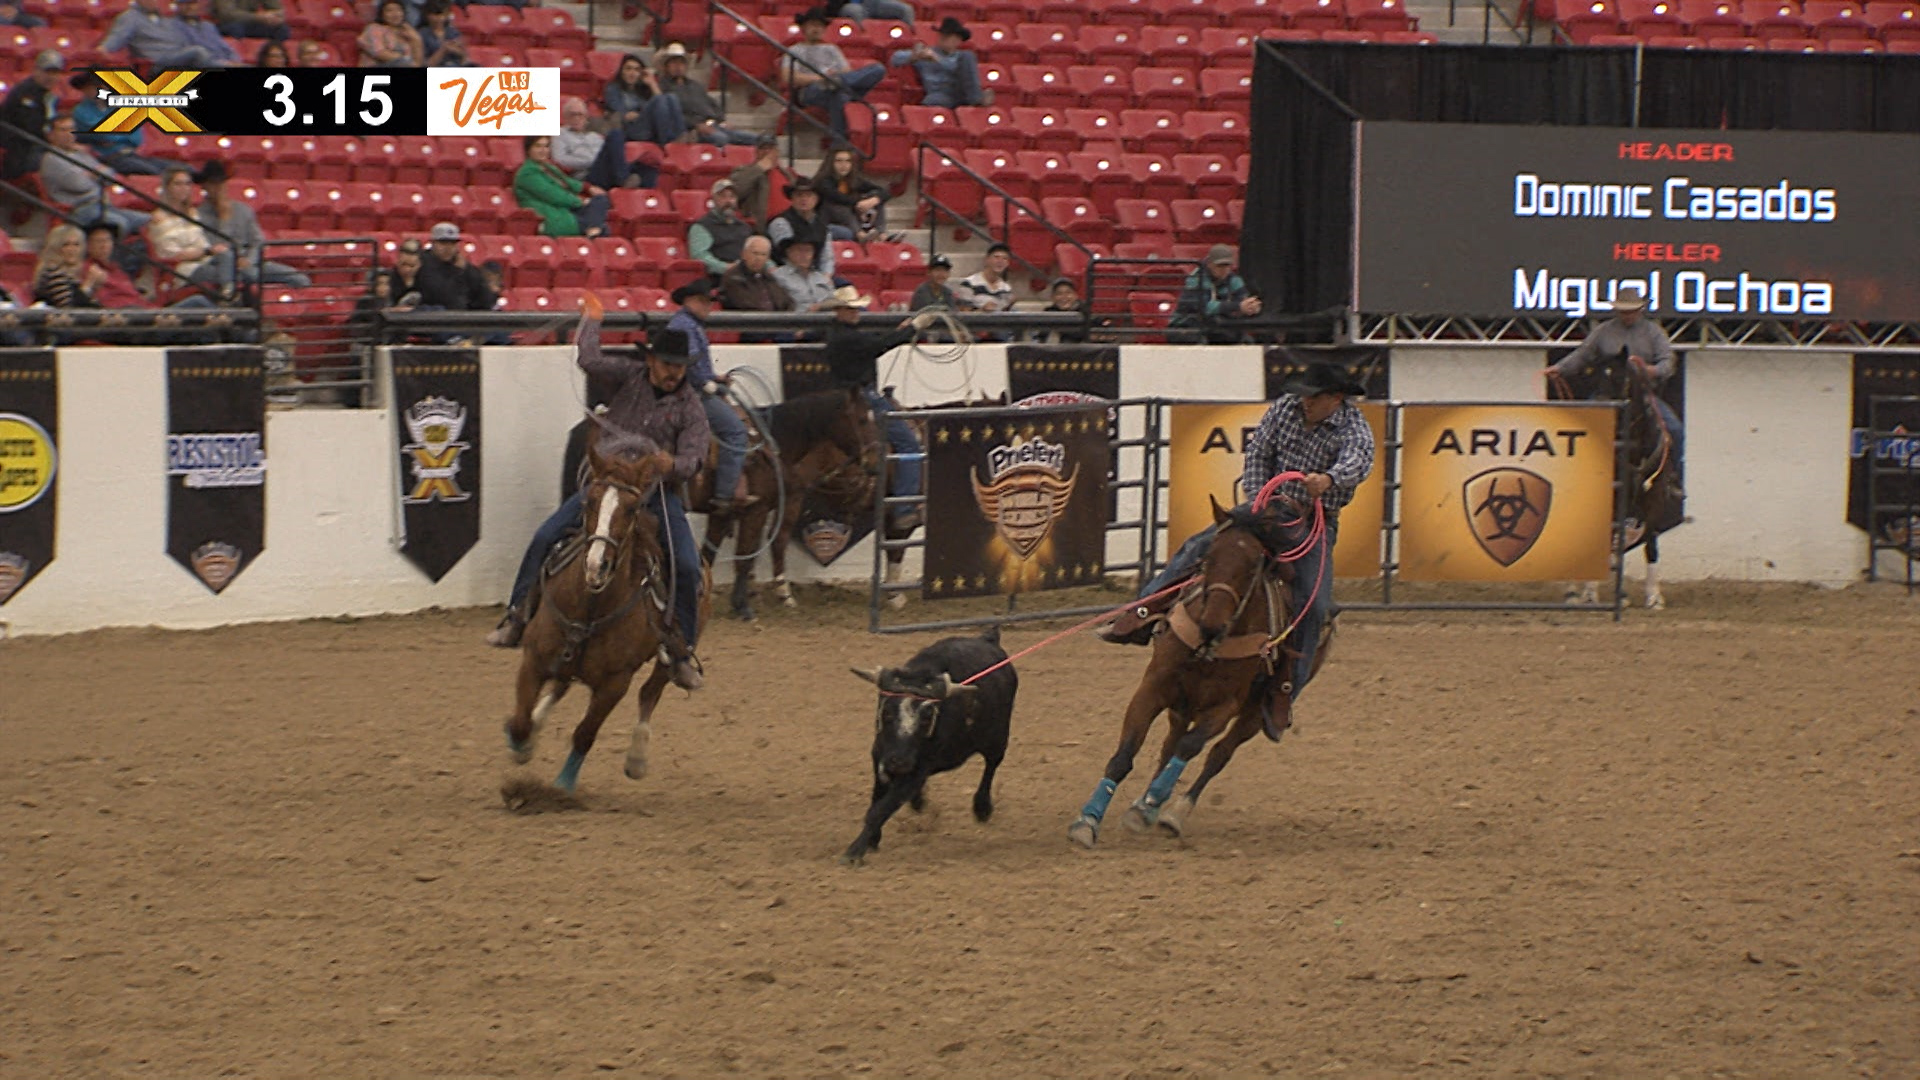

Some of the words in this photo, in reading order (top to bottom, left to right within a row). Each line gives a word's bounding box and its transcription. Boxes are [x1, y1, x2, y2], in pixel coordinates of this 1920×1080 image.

[1618, 143, 1735, 162] HEADER
[1514, 173, 1653, 217] Dominic
[1664, 177, 1837, 222] Casados
[1613, 243, 1721, 262] HEELER
[1674, 270, 1833, 314] Ochoa
[1431, 428, 1586, 456] ARIAT
